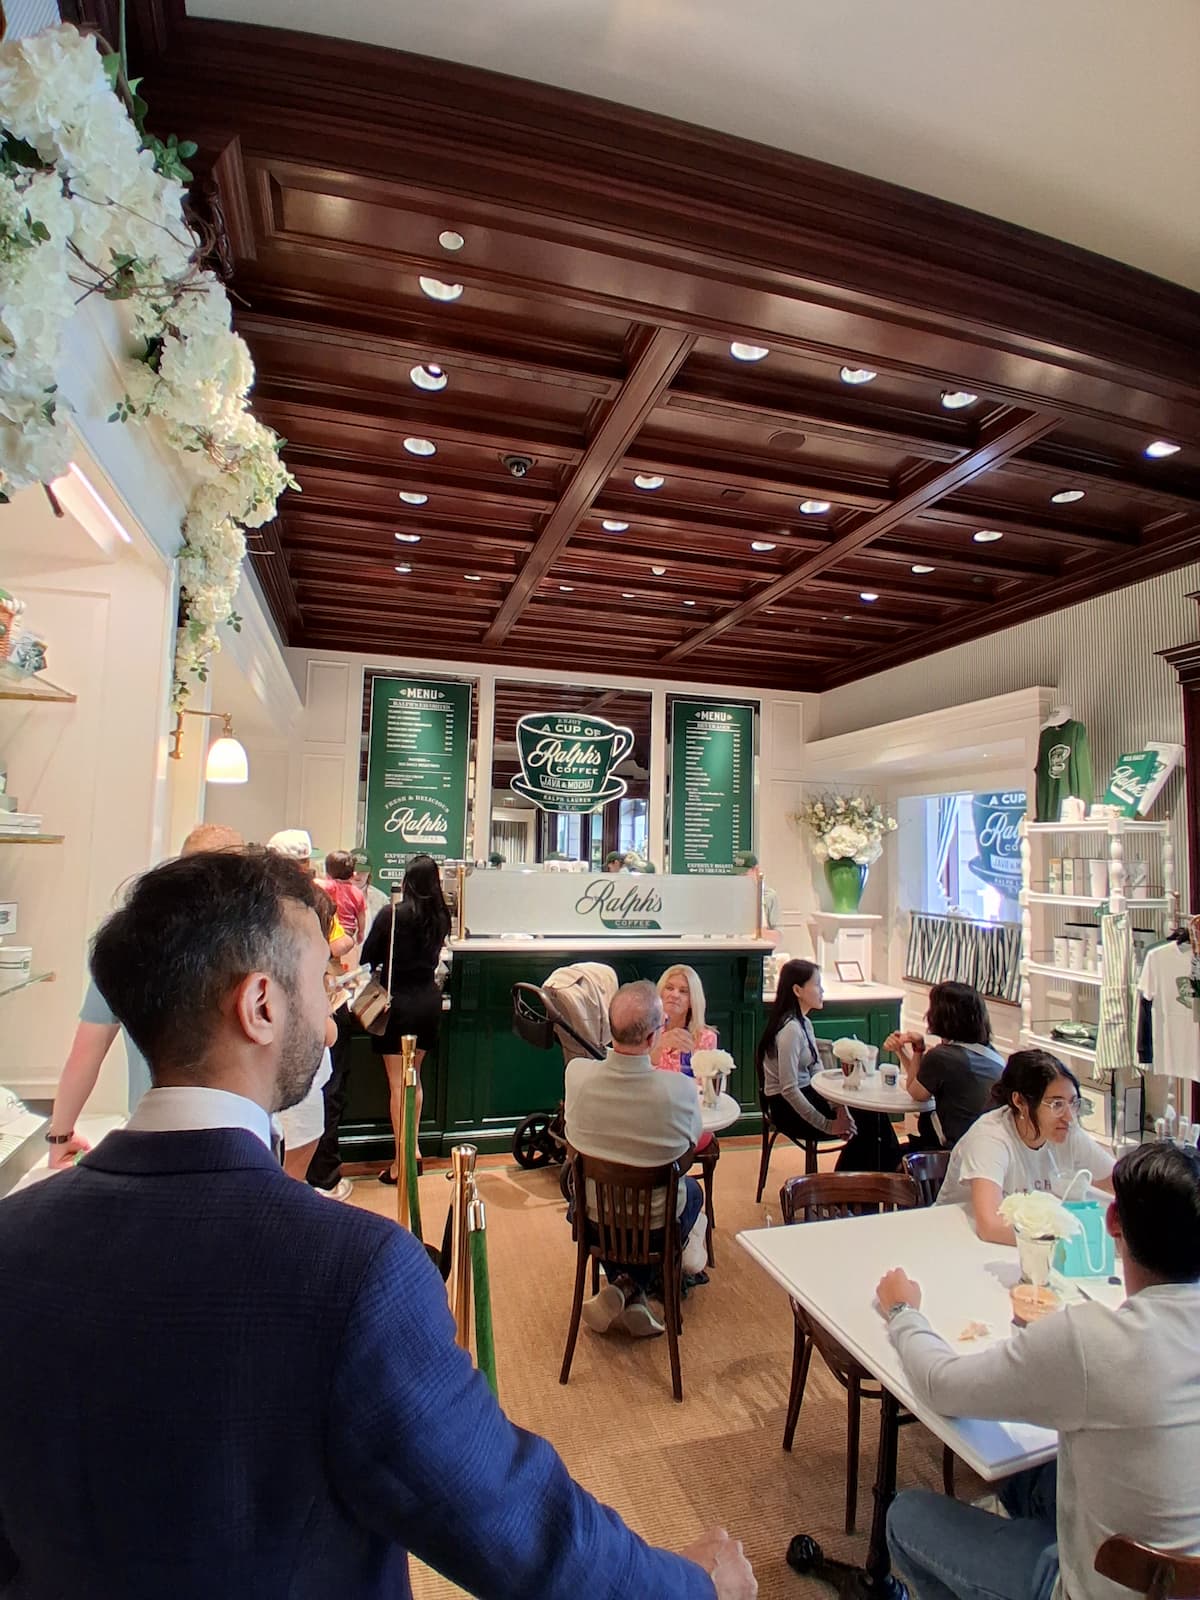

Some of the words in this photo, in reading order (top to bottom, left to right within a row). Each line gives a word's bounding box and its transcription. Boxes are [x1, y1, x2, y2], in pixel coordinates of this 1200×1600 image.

[407, 688, 437, 699] MENU
[701, 711, 726, 721] MENU
[542, 724, 551, 732] A
[555, 724, 582, 733] CUP
[584, 727, 601, 737] OF
[527, 738, 601, 776] Ralph's
[556, 766, 599, 775] COFFEE
[541, 776, 561, 788] JAVA
[567, 779, 592, 789] MOCHA
[384, 795, 407, 810] FRESH
[415, 795, 450, 813] DELICIOUS
[989, 795, 999, 806] A
[1001, 793, 1026, 804] CUP
[384, 806, 448, 836] Ralph's
[575, 879, 663, 920] Ralph's
